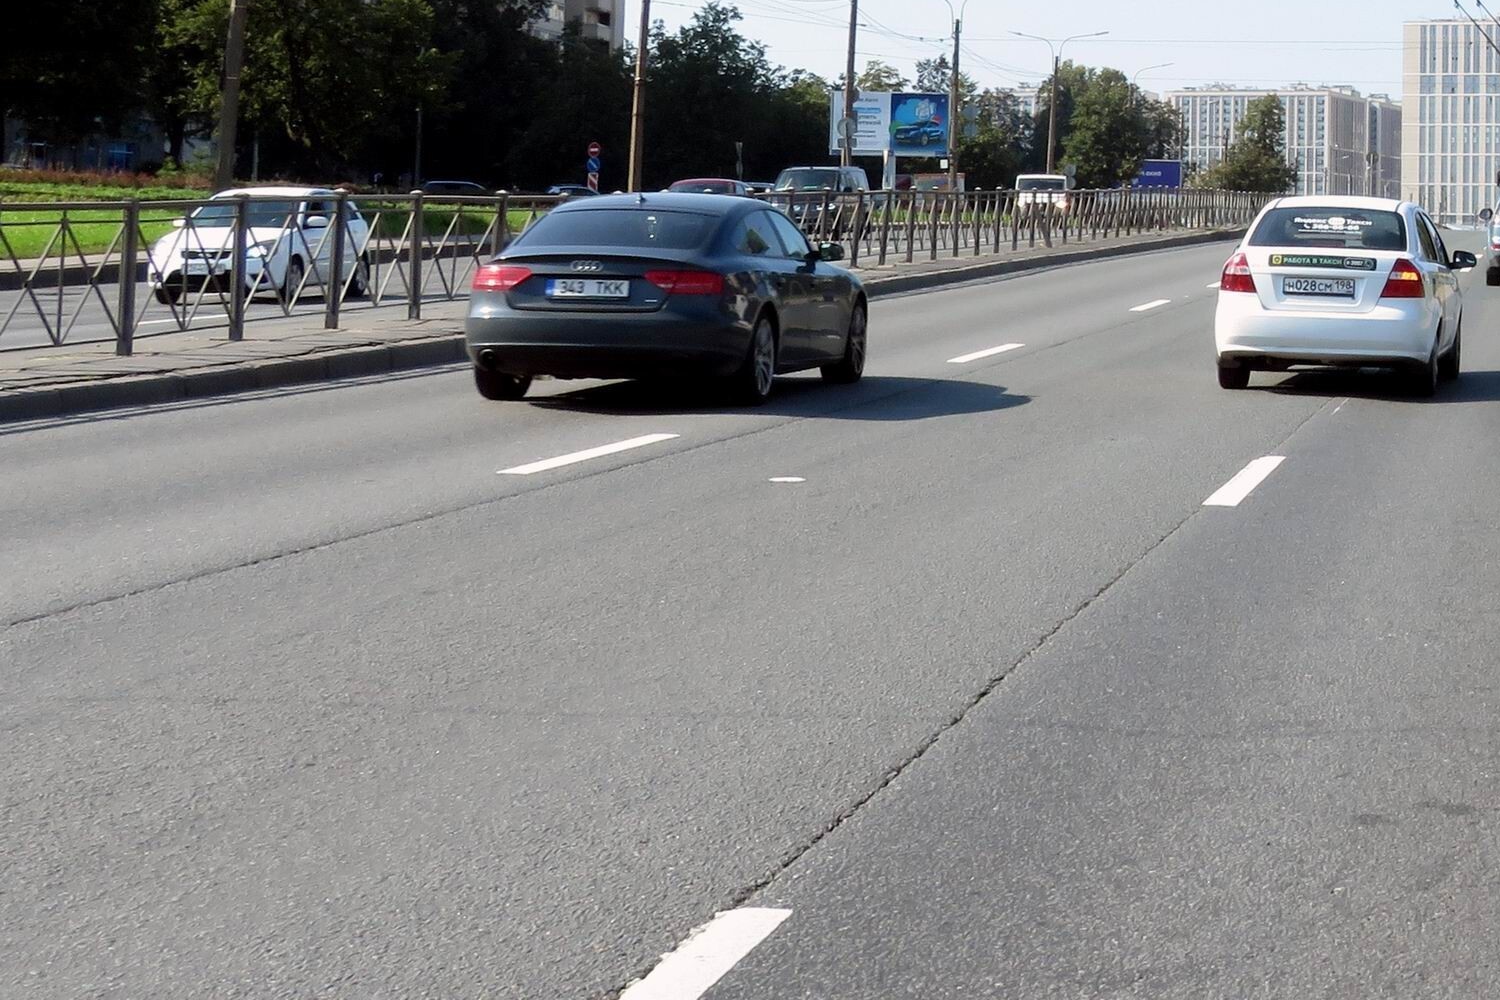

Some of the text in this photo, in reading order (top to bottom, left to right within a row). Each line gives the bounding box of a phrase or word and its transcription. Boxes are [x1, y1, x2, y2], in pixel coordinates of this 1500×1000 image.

[1283, 256, 1311, 264] РАБОТА
[1319, 257, 1343, 265] ТАКСИ
[560, 281, 625, 295] 343 TKK
